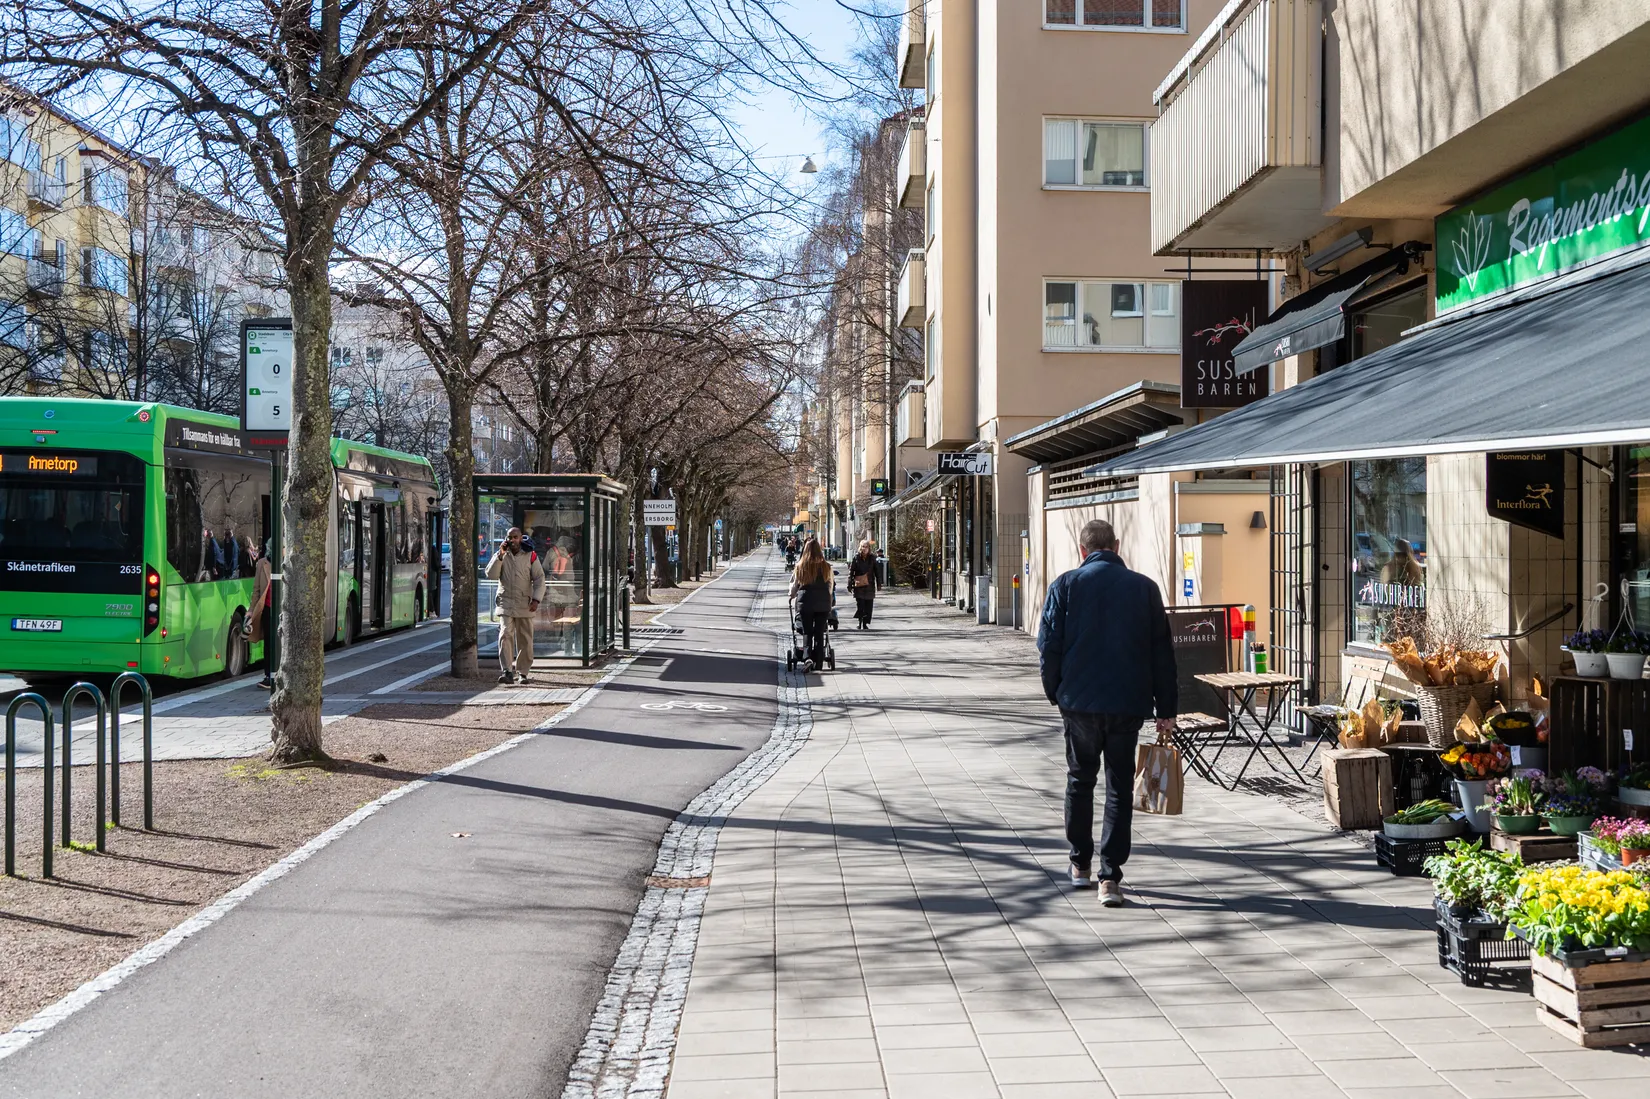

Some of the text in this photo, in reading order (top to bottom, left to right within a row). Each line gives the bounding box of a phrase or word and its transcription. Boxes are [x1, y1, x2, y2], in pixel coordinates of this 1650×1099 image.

[273, 364, 281, 374] 0
[1197, 360, 1256, 380] SUSI
[1198, 383, 1256, 396] BAREN
[273, 405, 281, 415] 5
[28, 455, 78, 474] Annetorp
[1496, 499, 1541, 509] Interflora
[7, 561, 142, 574] Skånetrafiken 2635
[20, 620, 57, 629] TFN 49F
